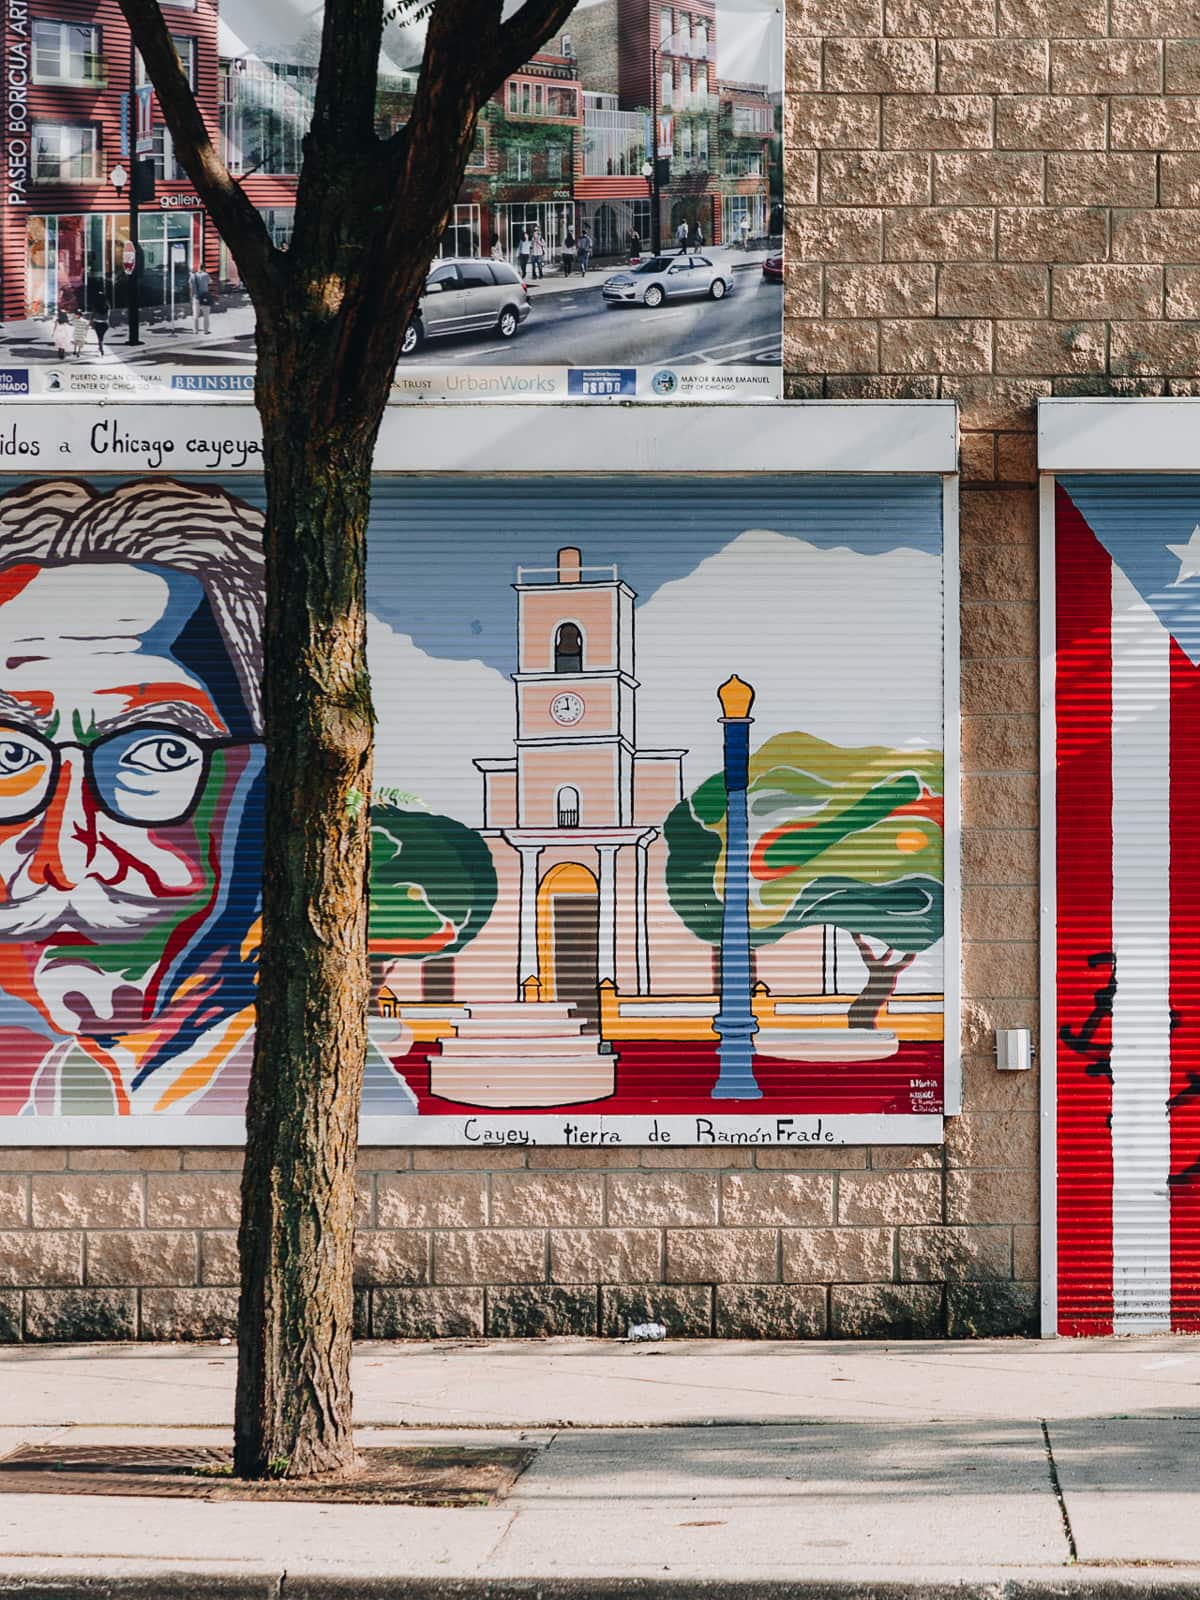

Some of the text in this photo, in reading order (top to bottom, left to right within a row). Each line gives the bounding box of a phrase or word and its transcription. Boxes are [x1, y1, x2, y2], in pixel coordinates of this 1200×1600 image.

[8, 42, 28, 132] BORICUA
[8, 139, 27, 205] PASEO
[160, 193, 202, 208] gallery
[403, 380, 432, 389] TRUST
[445, 375, 556, 392] UrbanWorks
[59, 441, 72, 454] a
[90, 419, 175, 468] Chicago
[464, 1118, 536, 1145] Cayey,
[563, 1122, 622, 1145] tierra
[648, 1119, 671, 1142] de
[696, 1118, 772, 1144] Ramón
